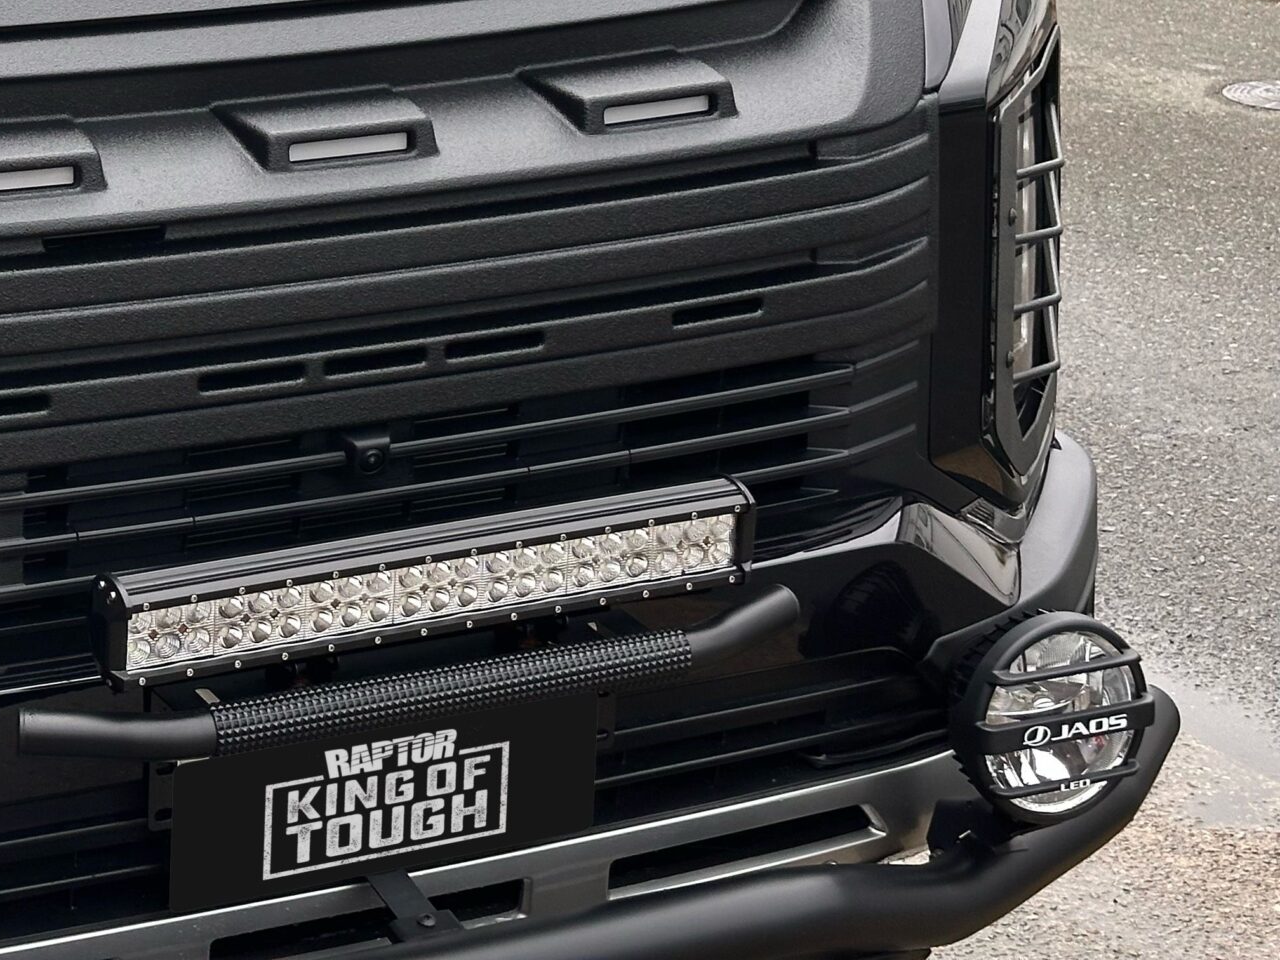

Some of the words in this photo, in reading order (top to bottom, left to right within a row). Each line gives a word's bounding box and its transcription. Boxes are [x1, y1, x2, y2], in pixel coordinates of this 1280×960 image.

[1051, 713, 1127, 741] JAOS
[324, 728, 458, 780] RAPTOR
[287, 771, 415, 824] KING
[426, 754, 491, 798] OF
[1060, 778, 1091, 792] LED
[285, 789, 488, 864] TOUGH
